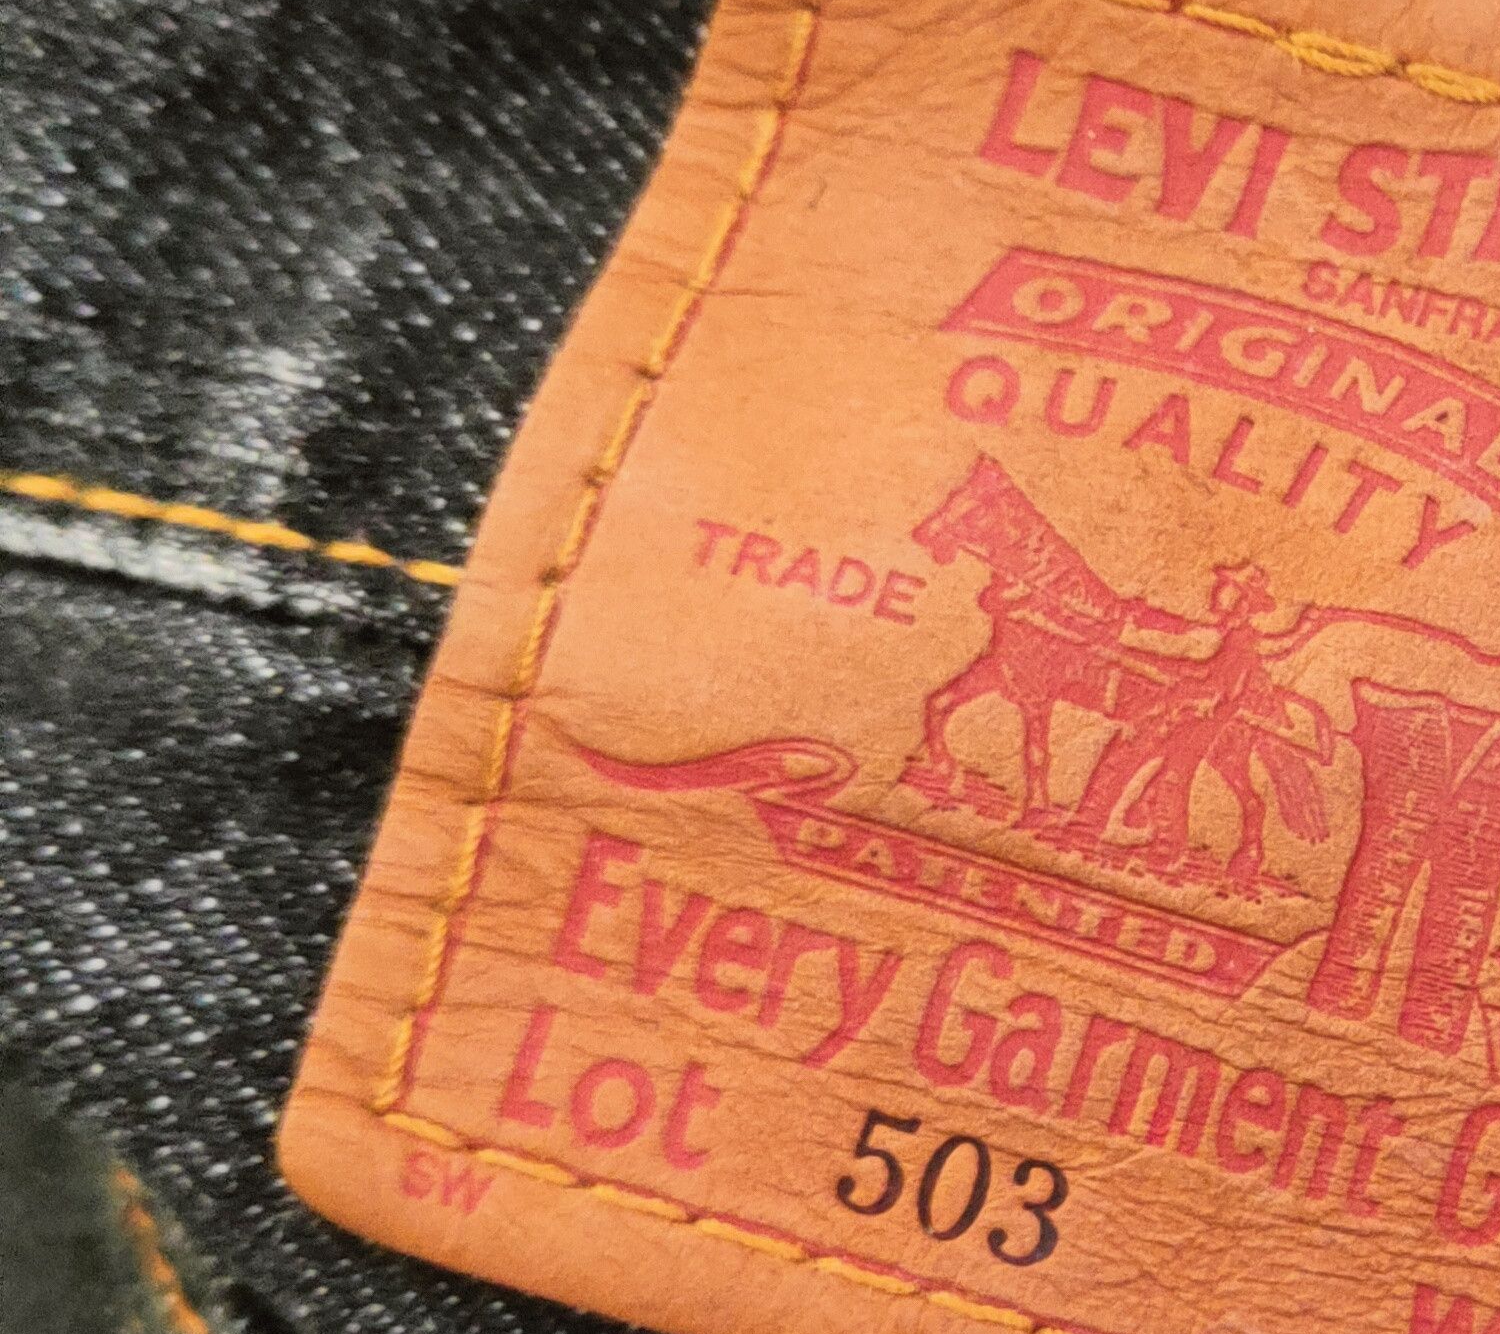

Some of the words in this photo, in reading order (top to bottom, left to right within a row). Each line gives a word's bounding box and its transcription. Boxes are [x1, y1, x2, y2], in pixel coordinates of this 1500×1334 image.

[978, 47, 1293, 240] LEVI
[944, 354, 1476, 567] QUALITY
[693, 517, 927, 626] TRADE
[796, 815, 1217, 972] PATENTED
[552, 827, 902, 1068] Every
[914, 939, 1405, 1218] Garment
[500, 1003, 721, 1171] Lot
[836, 1107, 1069, 1267] 503
